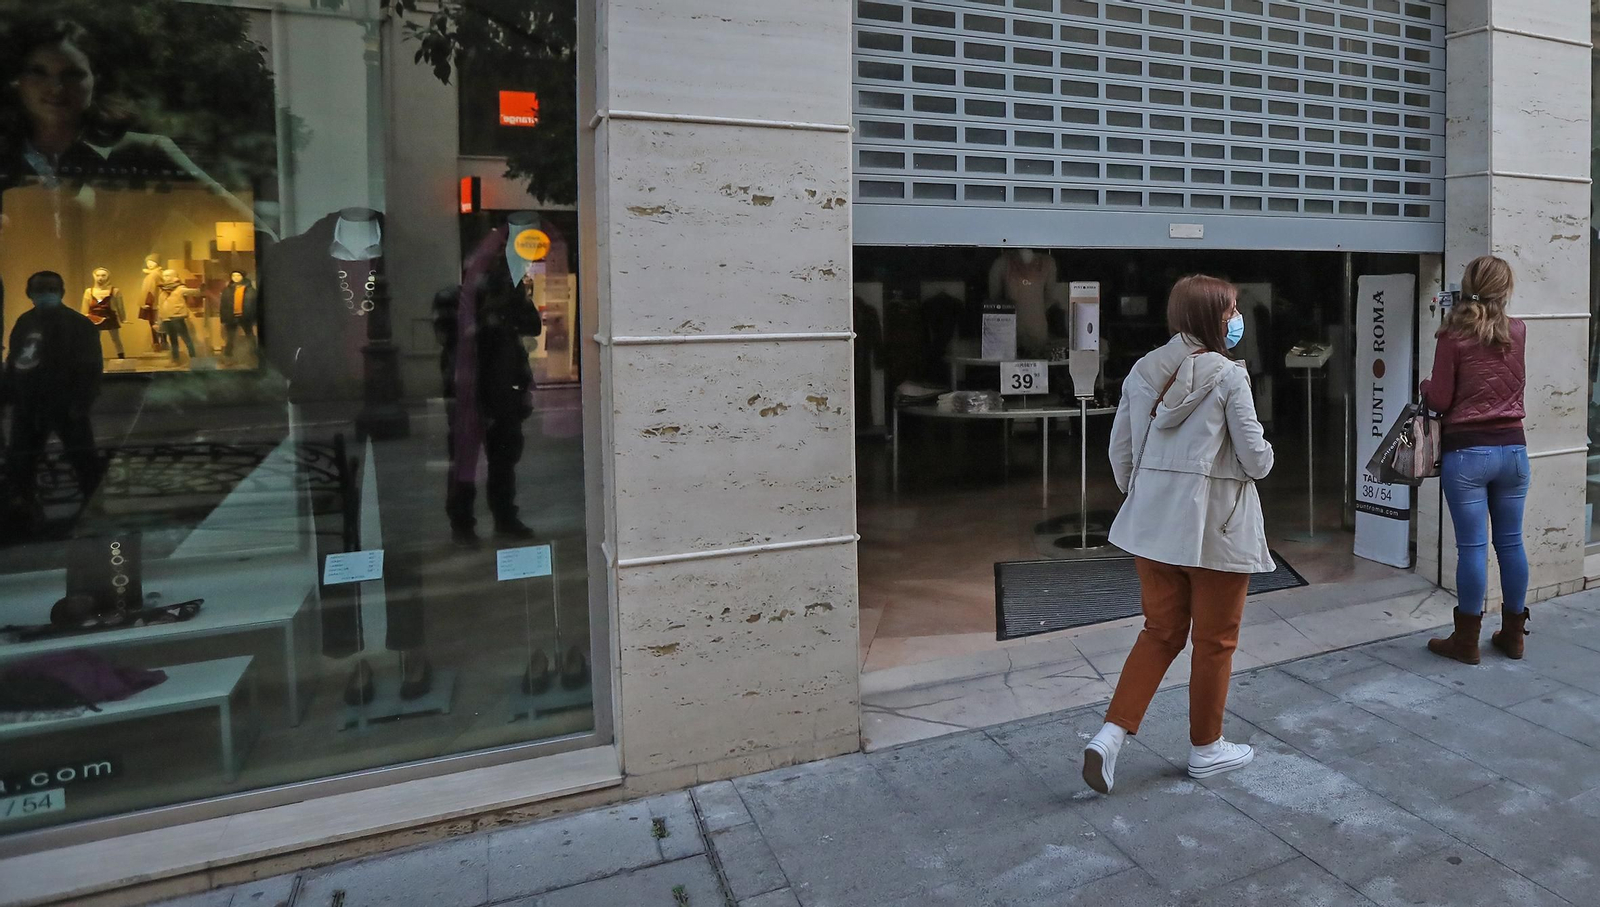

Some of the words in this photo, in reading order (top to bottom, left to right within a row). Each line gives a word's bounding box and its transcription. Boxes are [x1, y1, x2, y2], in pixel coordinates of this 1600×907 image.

[1372, 290, 1385, 353] ROMA
[1011, 373, 1033, 389] 39
[1372, 382, 1384, 438] PUNT
